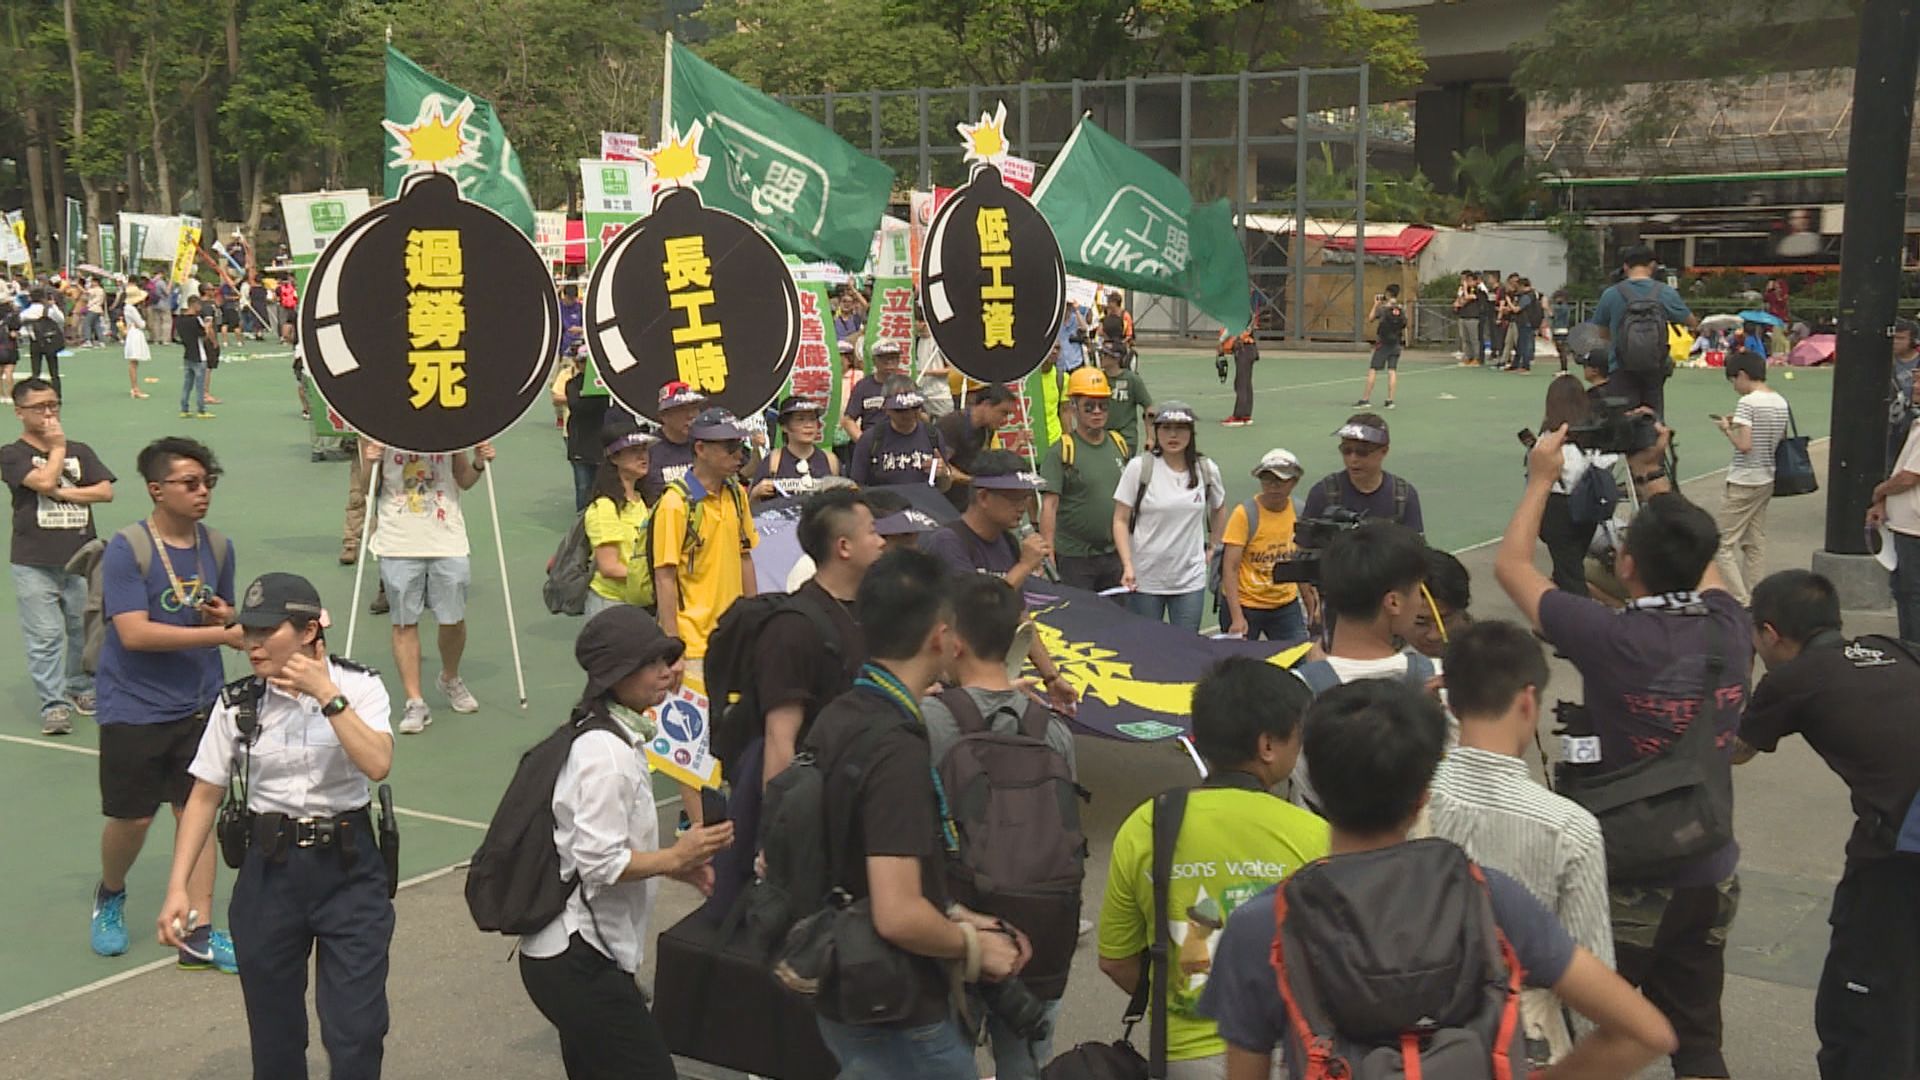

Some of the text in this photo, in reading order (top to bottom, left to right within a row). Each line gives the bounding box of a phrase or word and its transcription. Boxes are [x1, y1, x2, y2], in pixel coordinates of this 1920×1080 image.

[404, 229, 467, 409] 過勞死
[664, 235, 728, 394] 長工時
[976, 206, 1015, 348] 低工資
[1225, 859, 1287, 878] water
